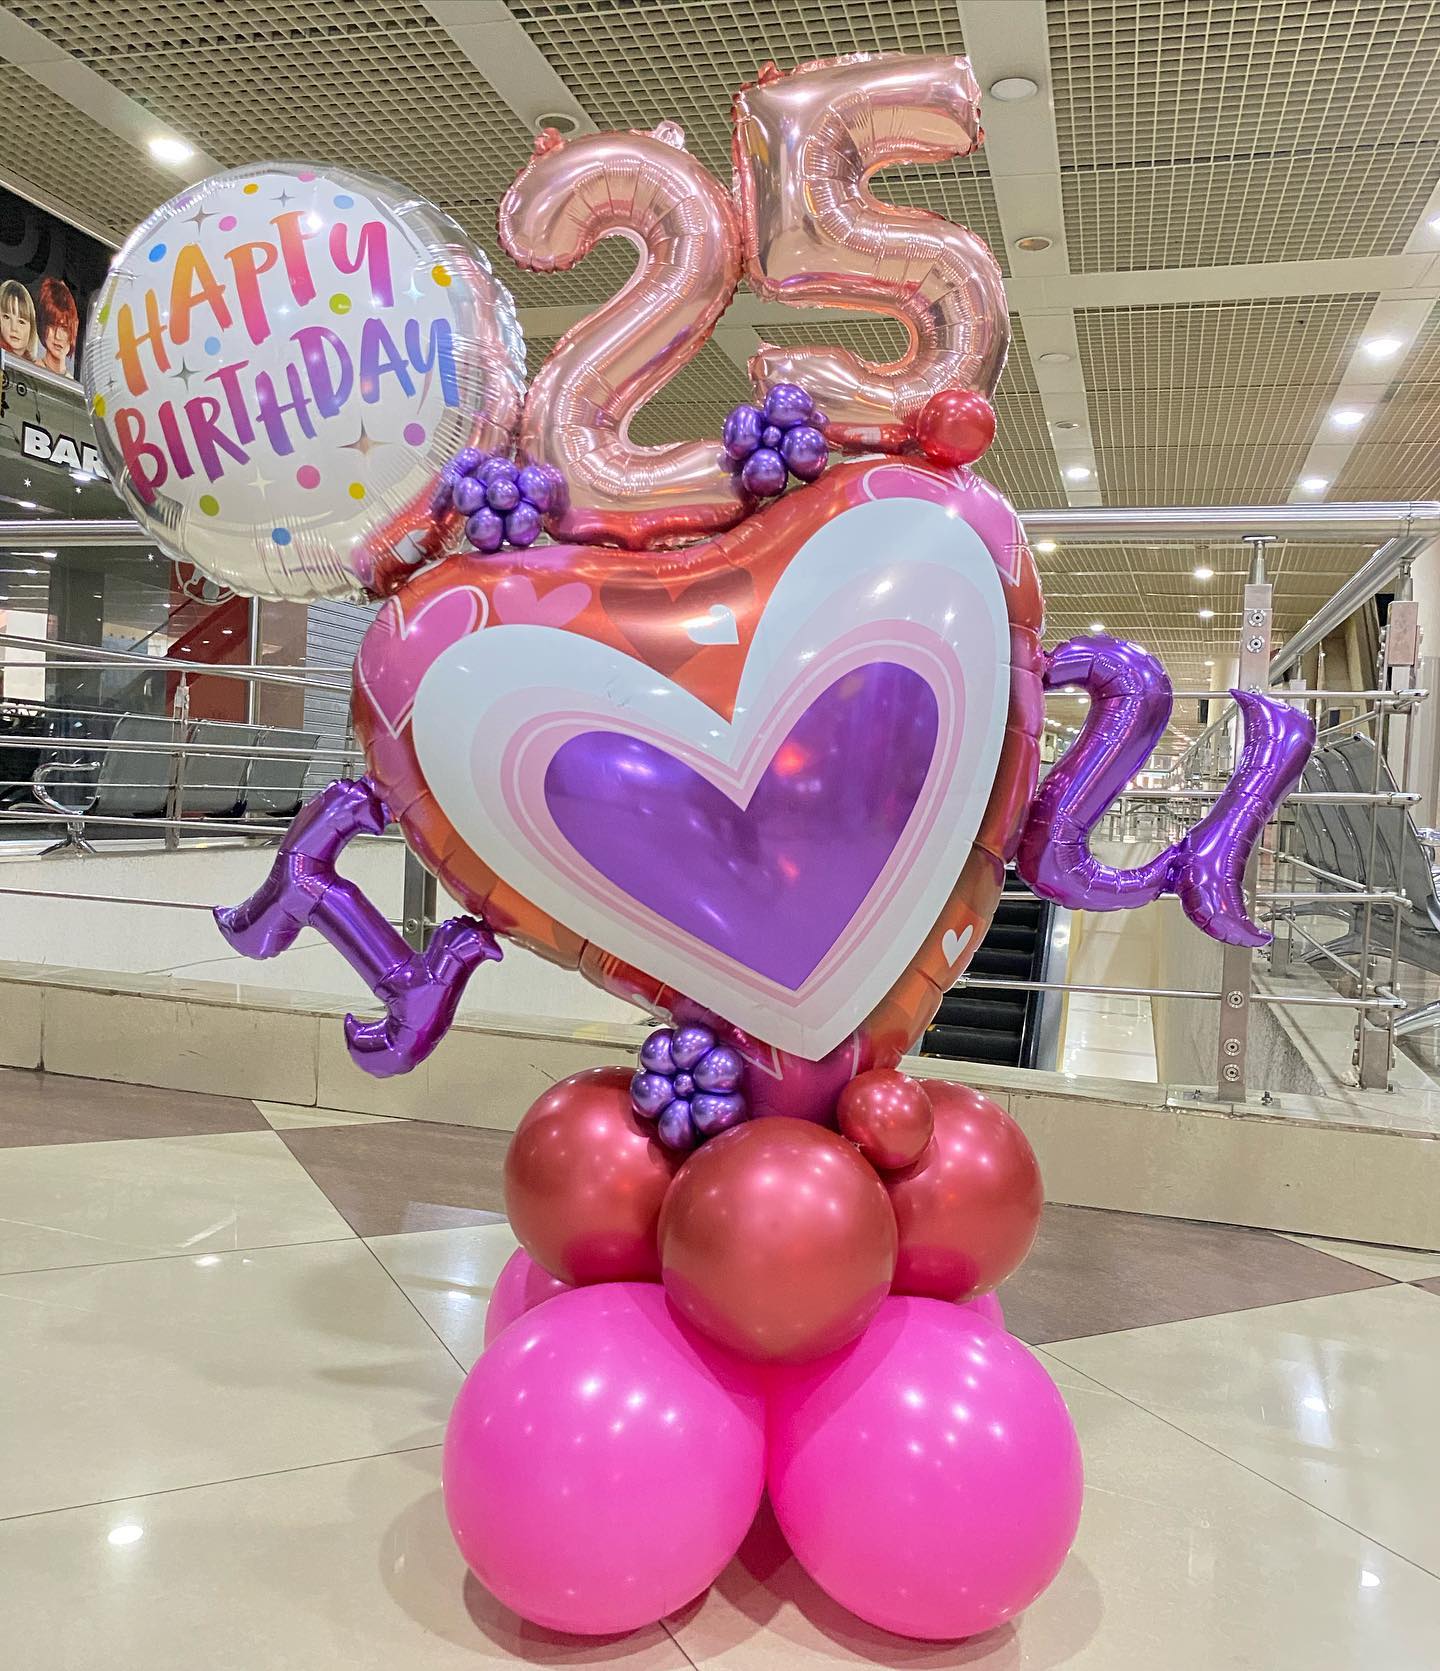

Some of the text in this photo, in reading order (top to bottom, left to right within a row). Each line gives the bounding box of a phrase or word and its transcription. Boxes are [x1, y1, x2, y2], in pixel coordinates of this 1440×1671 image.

[115, 210, 395, 397] HAPPY
[498, 52, 1010, 551] 25
[113, 317, 460, 502] BIRTHDAY
